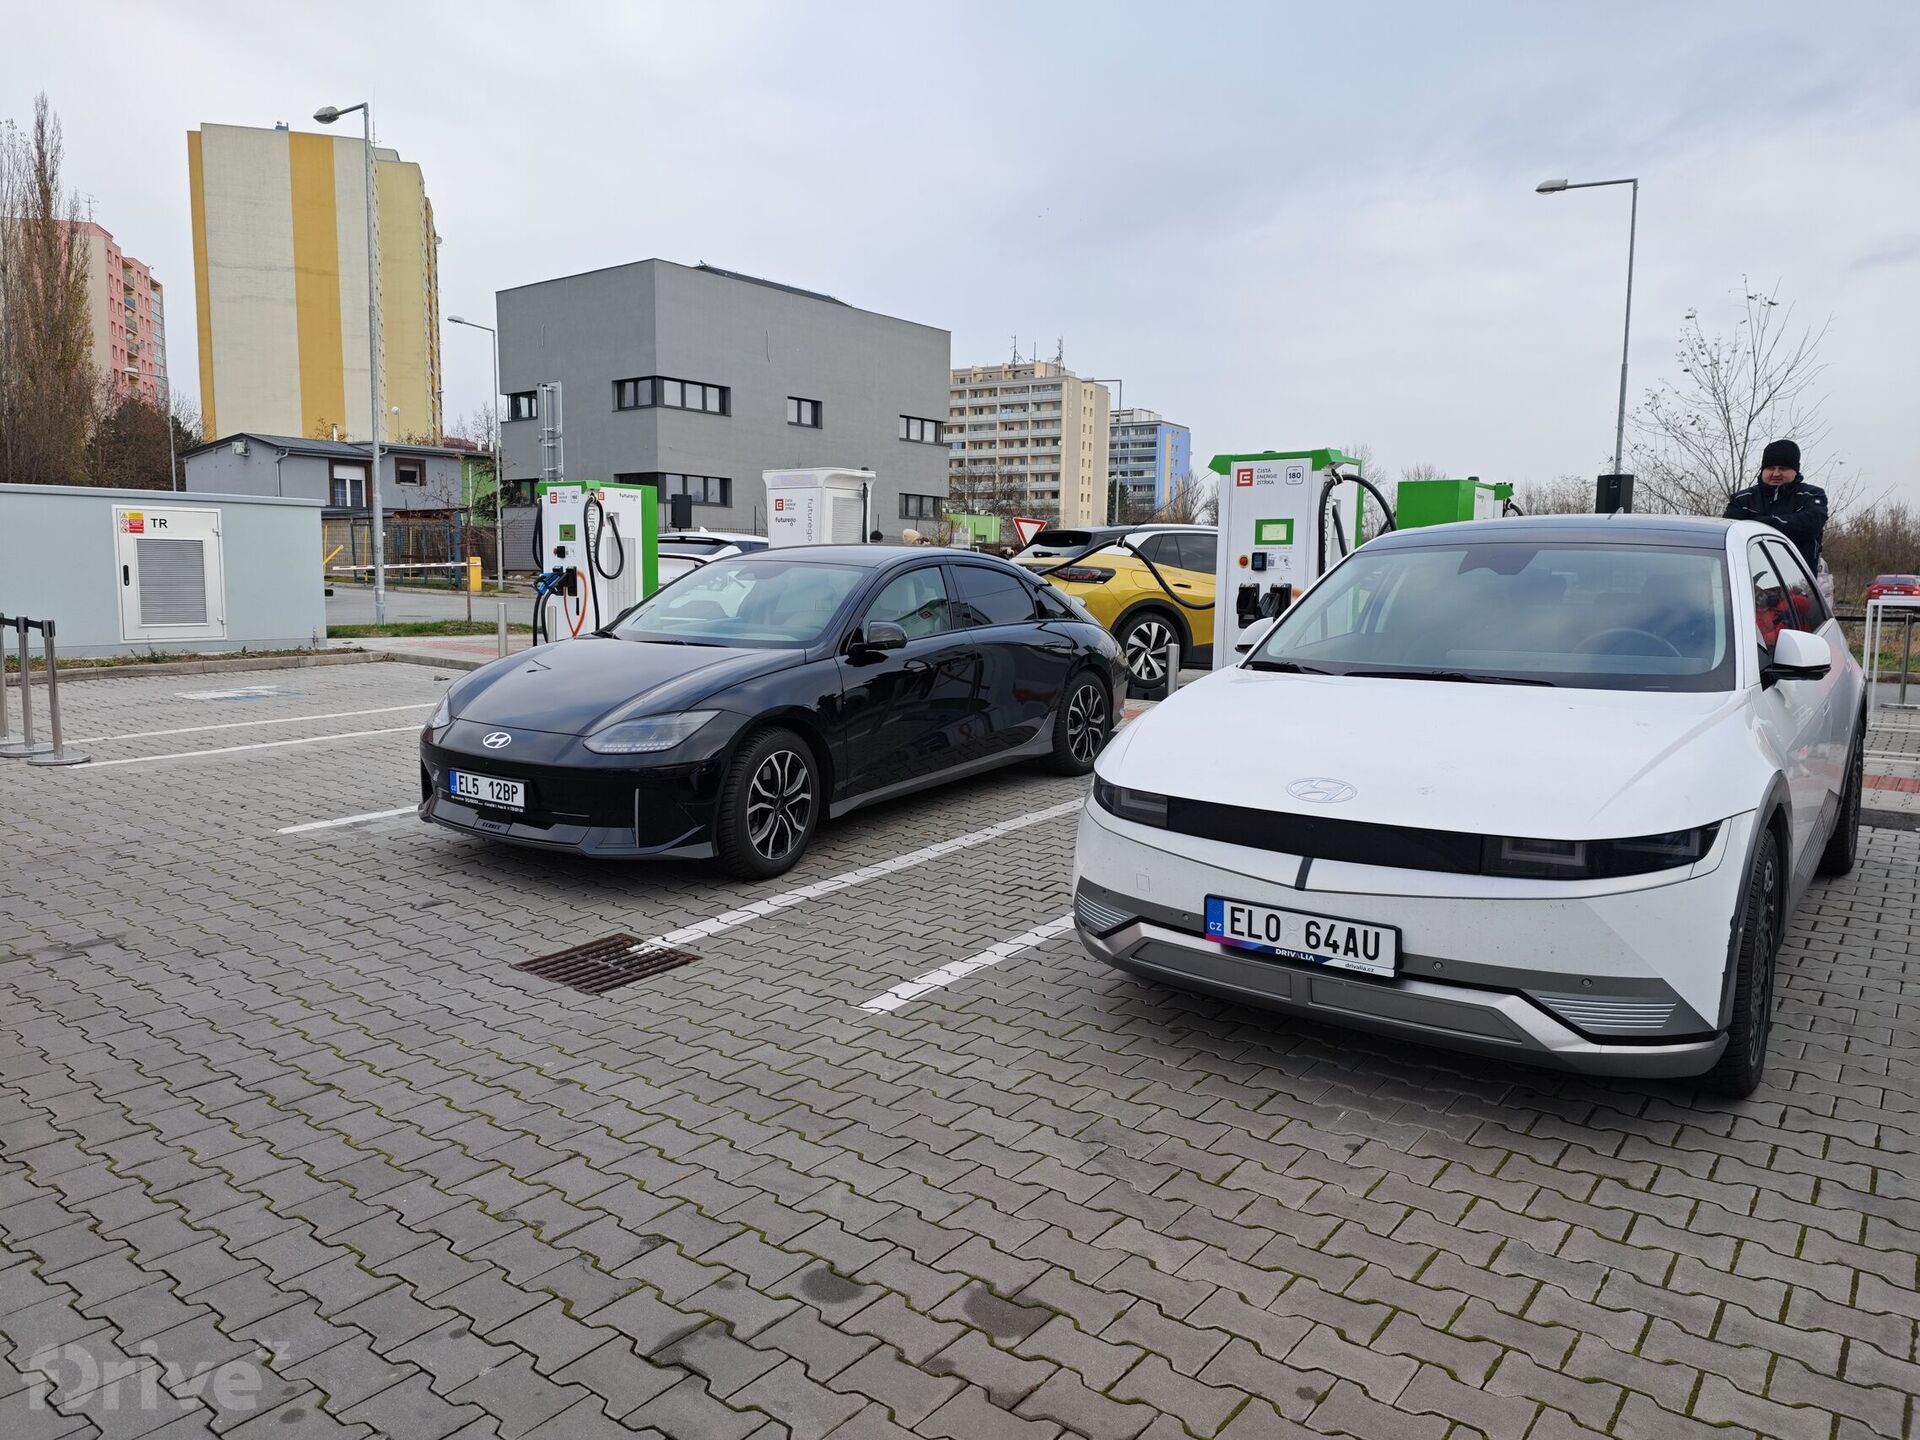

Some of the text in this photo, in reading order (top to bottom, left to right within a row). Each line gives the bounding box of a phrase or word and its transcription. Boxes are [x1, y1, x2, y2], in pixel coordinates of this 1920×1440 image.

[150, 518, 168, 528] TR
[459, 775, 518, 802] EL5 12BP
[1209, 921, 1222, 931] CZ
[1305, 920, 1380, 961] 64AU
[1275, 948, 1315, 961] DRIVALIA
[1344, 962, 1375, 973] drivalia.cz
